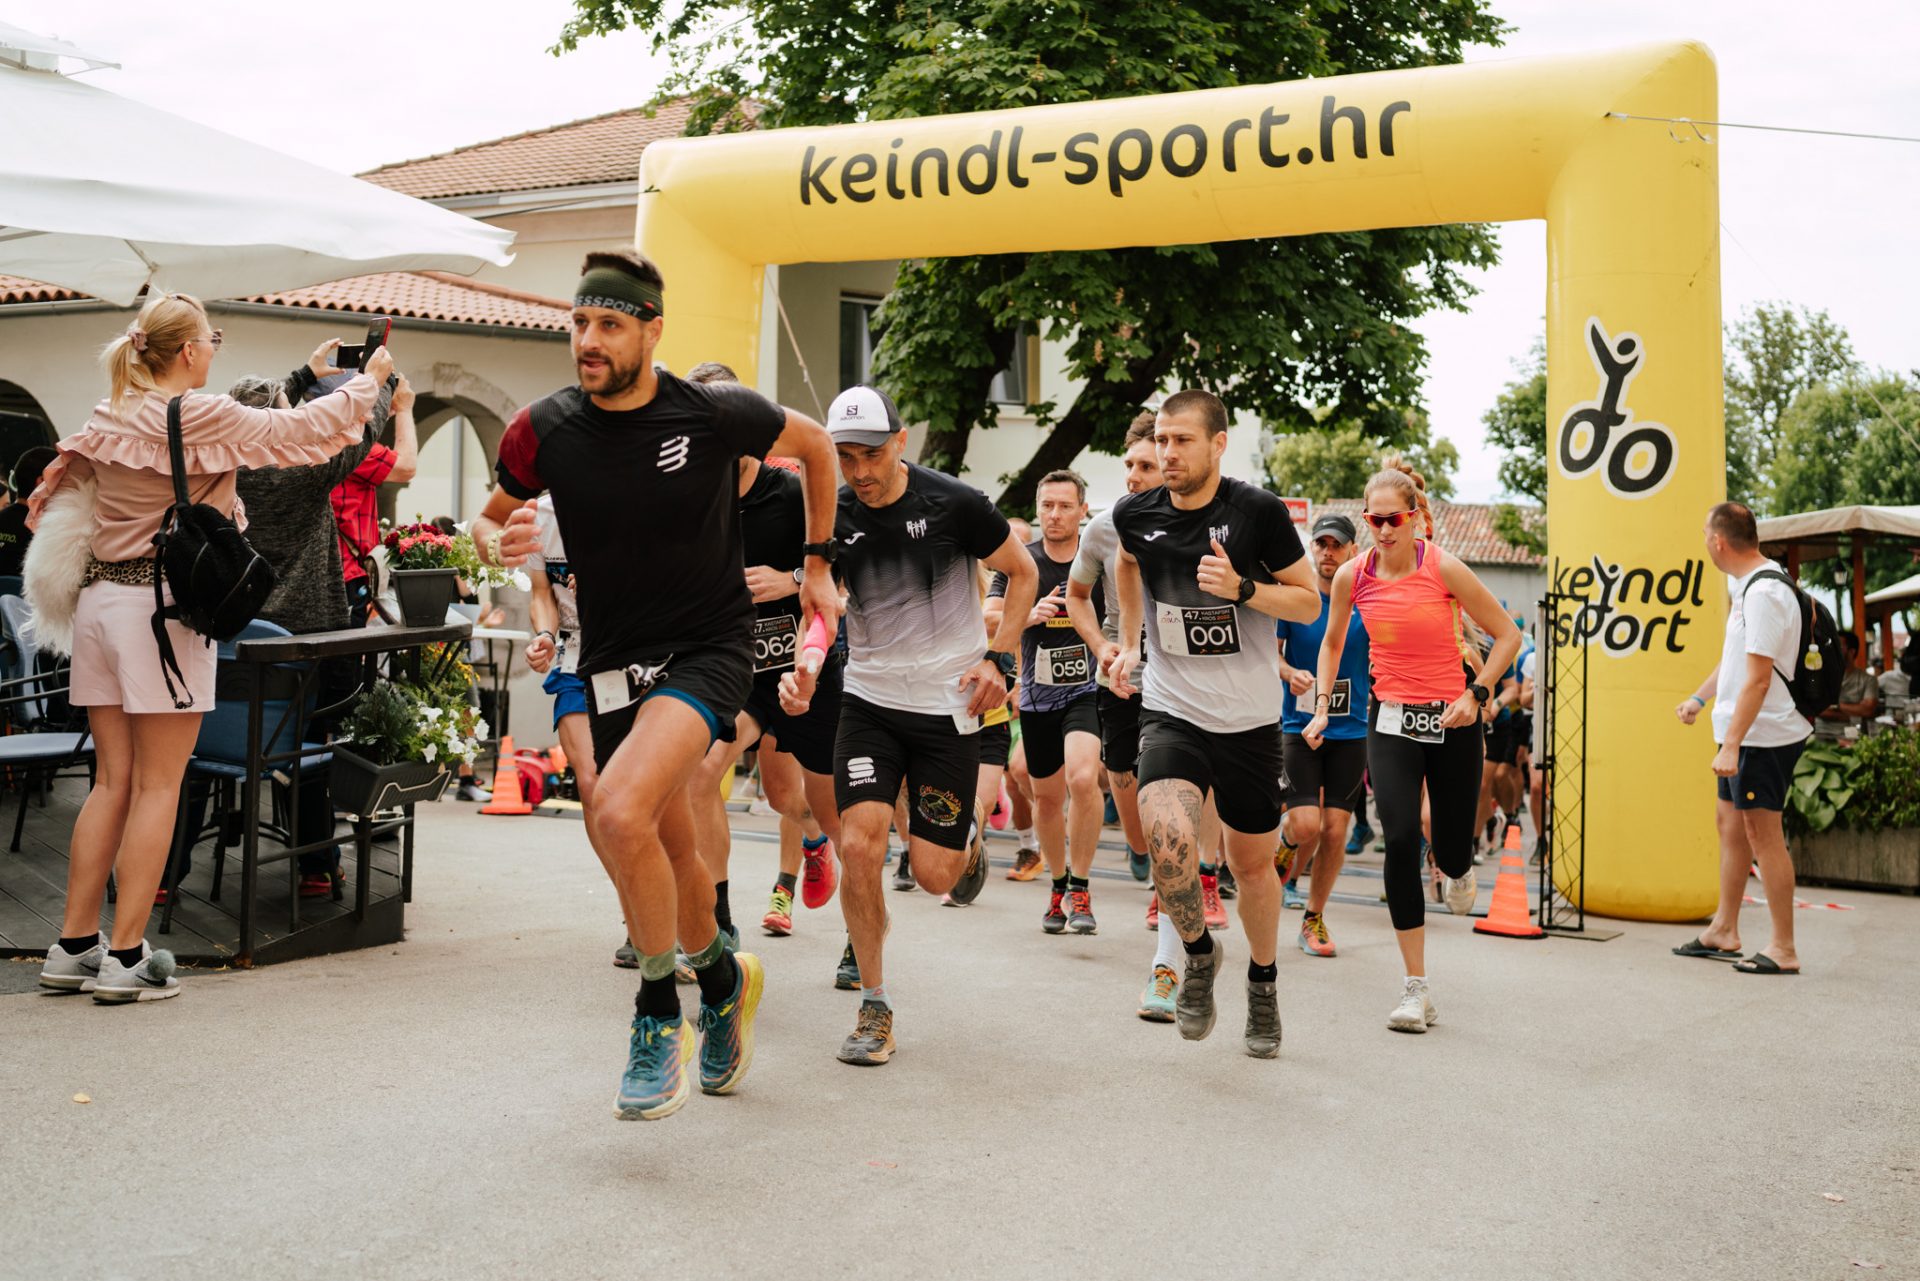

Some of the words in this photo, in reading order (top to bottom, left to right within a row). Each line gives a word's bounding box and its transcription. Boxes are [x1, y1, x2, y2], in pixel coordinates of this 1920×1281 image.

[800, 95, 1411, 206] keindl-sport.hr
[1184, 610, 1202, 621] 47.
[1190, 624, 1234, 646] 001
[1555, 608, 1691, 653] sport
[755, 633, 797, 660] 062
[1052, 659, 1087, 677] 059
[1402, 711, 1442, 733] 086
[848, 776, 877, 787] sportful
